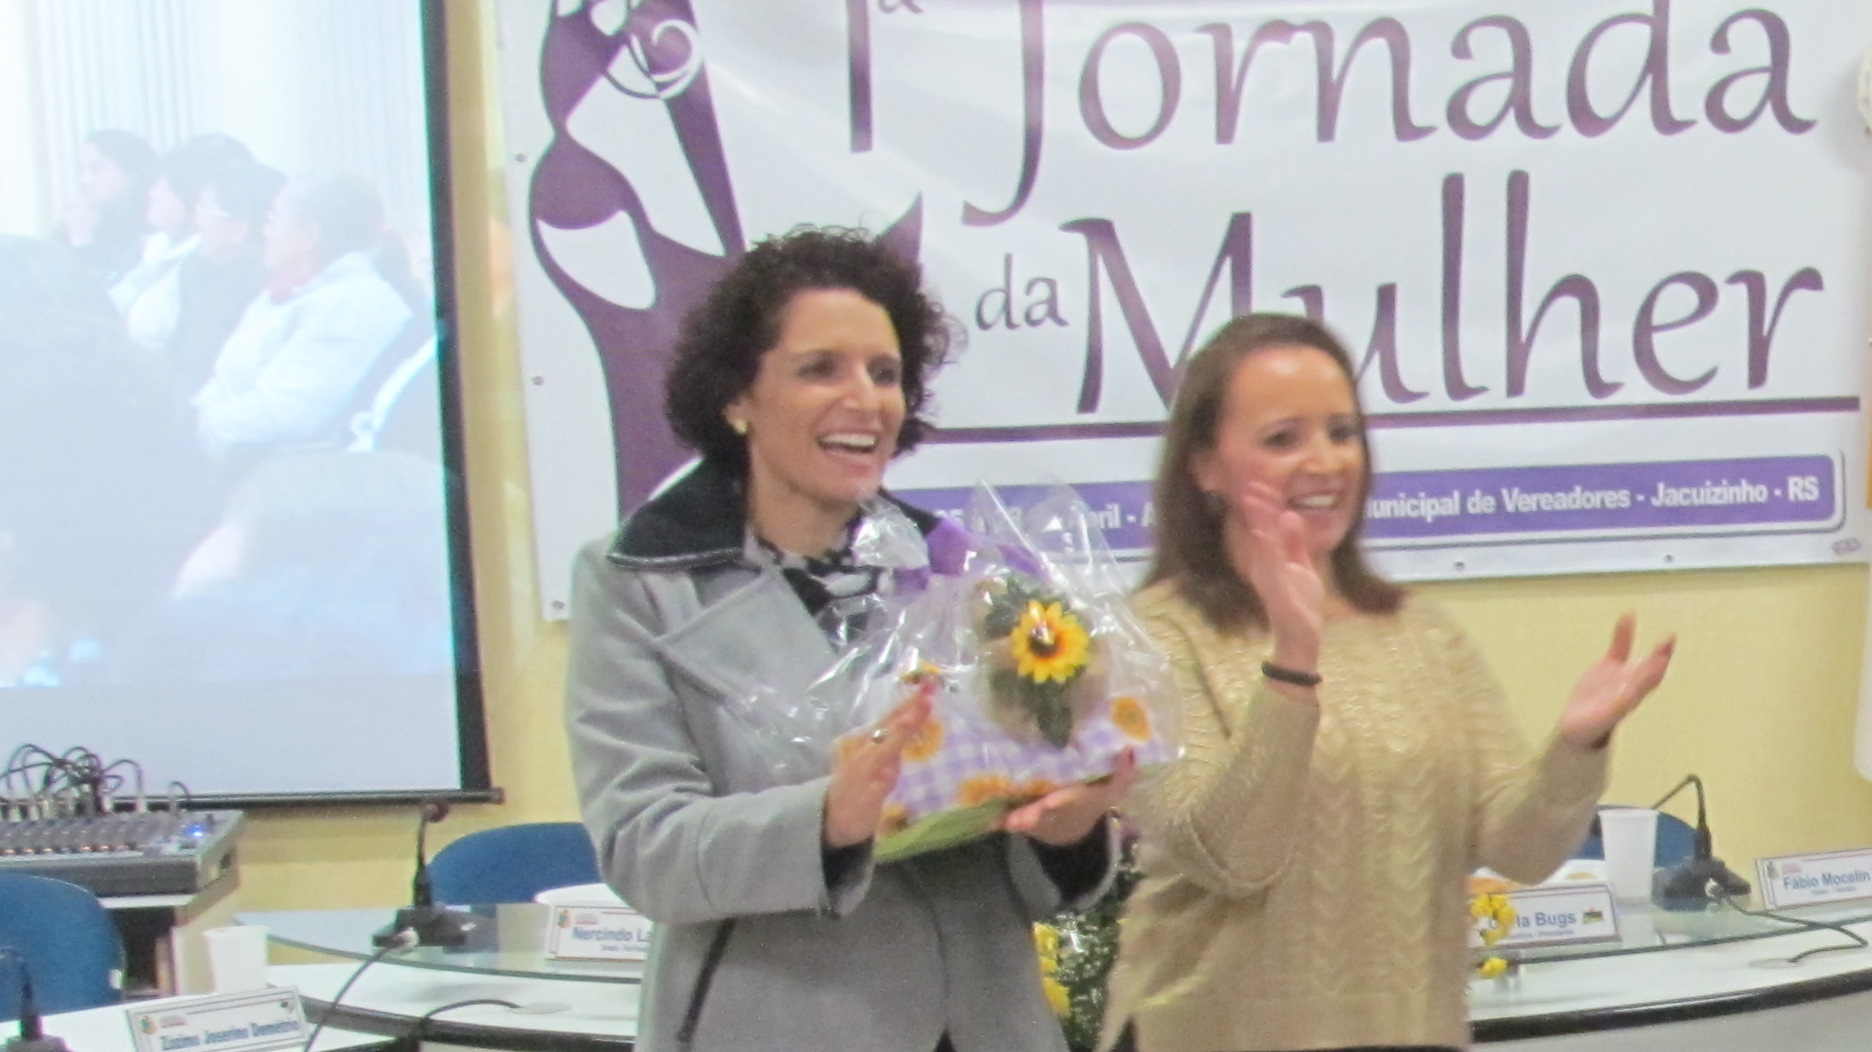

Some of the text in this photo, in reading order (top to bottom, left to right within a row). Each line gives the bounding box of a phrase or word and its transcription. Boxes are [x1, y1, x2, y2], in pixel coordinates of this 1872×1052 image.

[961, 0, 1818, 227] Jornada
[975, 169, 1824, 414] da Mulher
[1466, 487, 1496, 514] de
[1501, 482, 1631, 513] Vereadores
[1650, 478, 1768, 508] Jacuizinho
[1787, 475, 1820, 501] RS
[1534, 911, 1577, 929] Bugs
